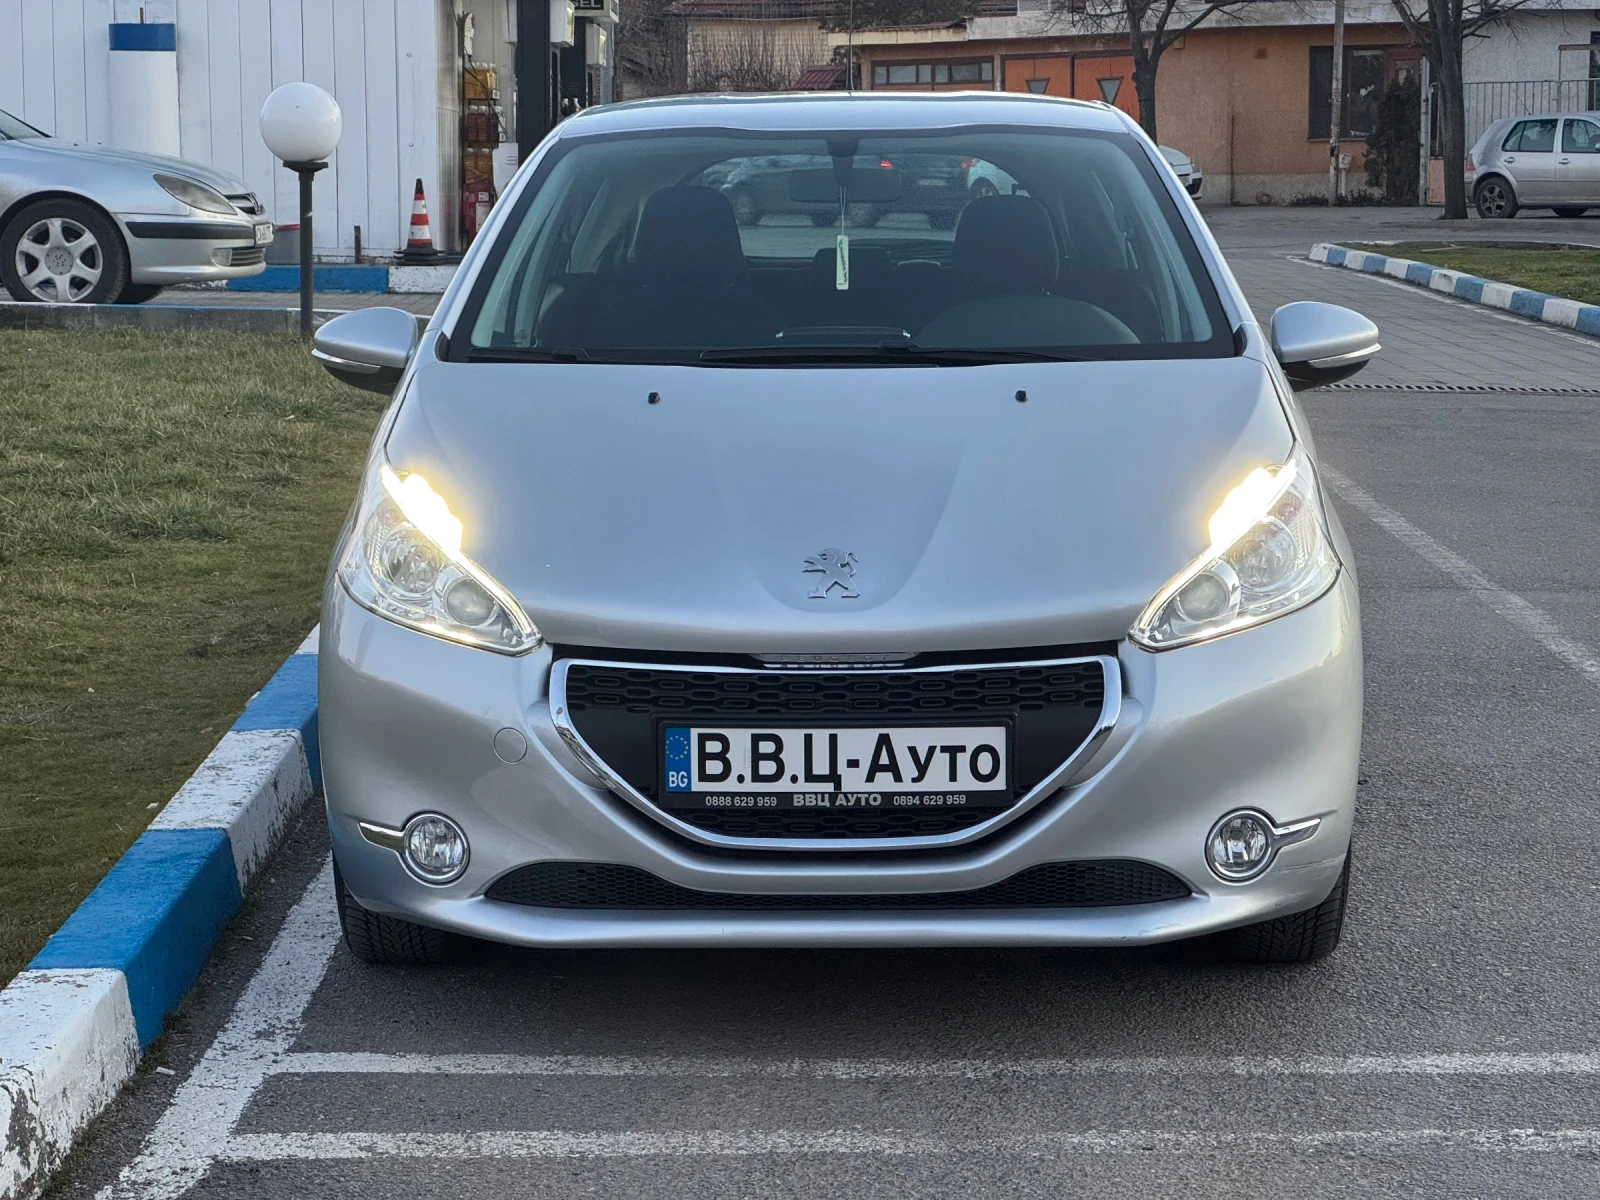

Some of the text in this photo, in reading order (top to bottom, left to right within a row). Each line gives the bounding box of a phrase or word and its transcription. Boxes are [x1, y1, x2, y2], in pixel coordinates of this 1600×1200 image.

[668, 771, 688, 788] BG
[705, 796, 777, 807] 0888 629 959
[793, 793, 882, 808] ВВЦ АУТО
[893, 794, 967, 806] 0894 629 959
